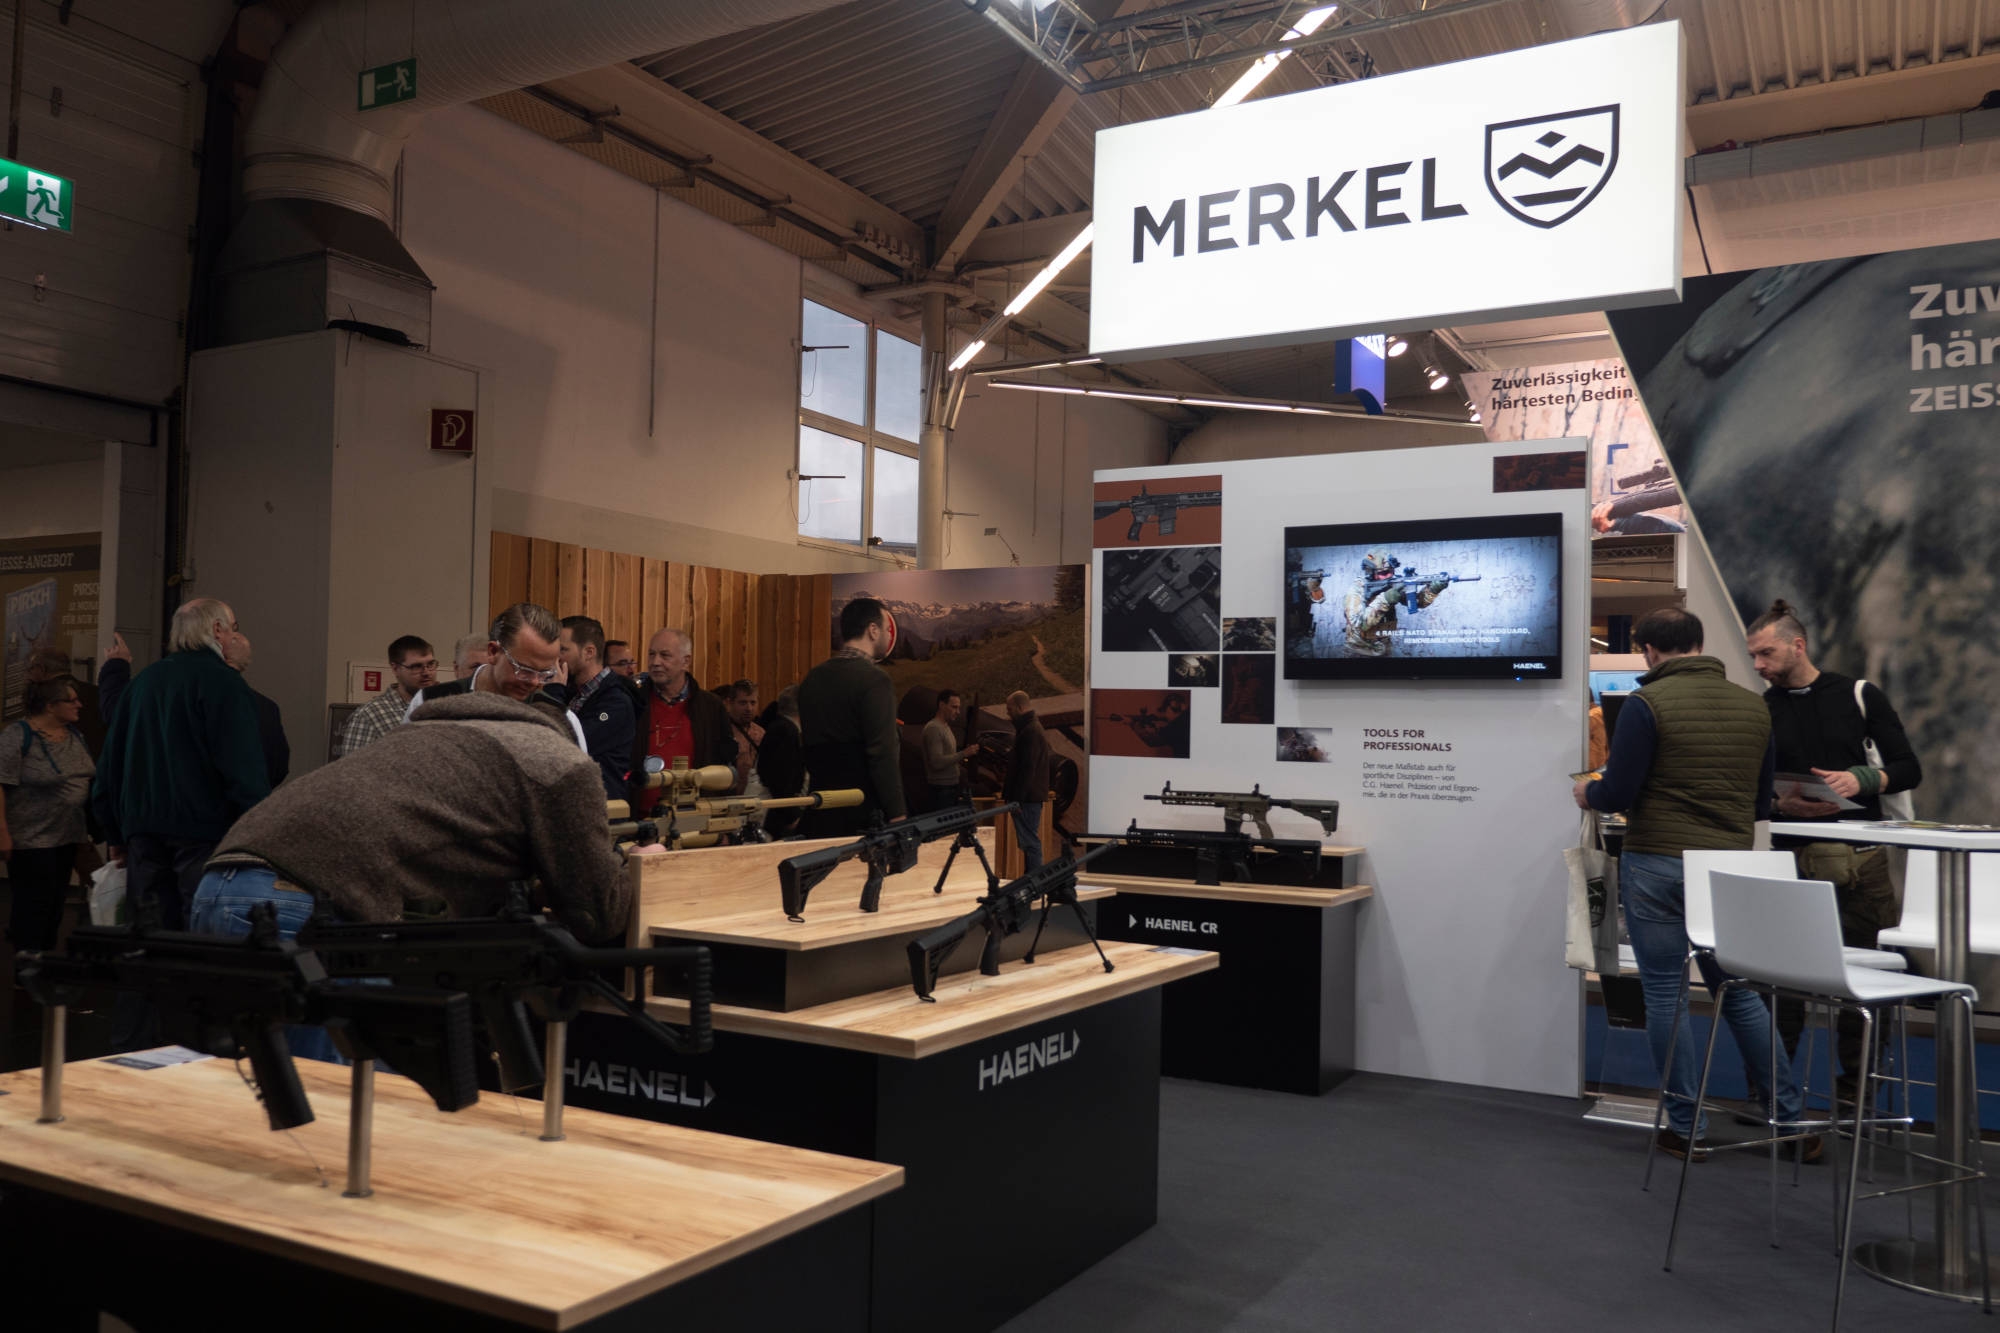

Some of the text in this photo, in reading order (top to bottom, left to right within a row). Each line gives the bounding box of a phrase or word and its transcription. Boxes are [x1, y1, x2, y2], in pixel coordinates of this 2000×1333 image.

[1133, 158, 1469, 264] MERKEL
[1909, 283, 2000, 320] Zuv
[1910, 330, 2000, 370] här
[1491, 366, 1627, 390] Zuverlässigkeit
[1491, 386, 1639, 410] härtesten Bedin
[1909, 382, 2000, 413] ZEIS
[1513, 662, 1547, 670] HAENEL
[1363, 728, 1425, 738] TOOLS FOR
[1363, 741, 1452, 752] PROFESSIONALS
[1363, 771, 1395, 780] sportliche
[1397, 772, 1433, 782] Disziplinen
[1395, 763, 1425, 771] Maßstab
[1445, 764, 1456, 772] für
[1377, 791, 1388, 799] die
[1410, 792, 1430, 800] Praxis
[1438, 783, 1451, 791] und
[1453, 784, 1480, 793] Ergono-
[1145, 917, 1219, 935] HAENEL CR
[979, 1031, 1072, 1091] HAENEL
